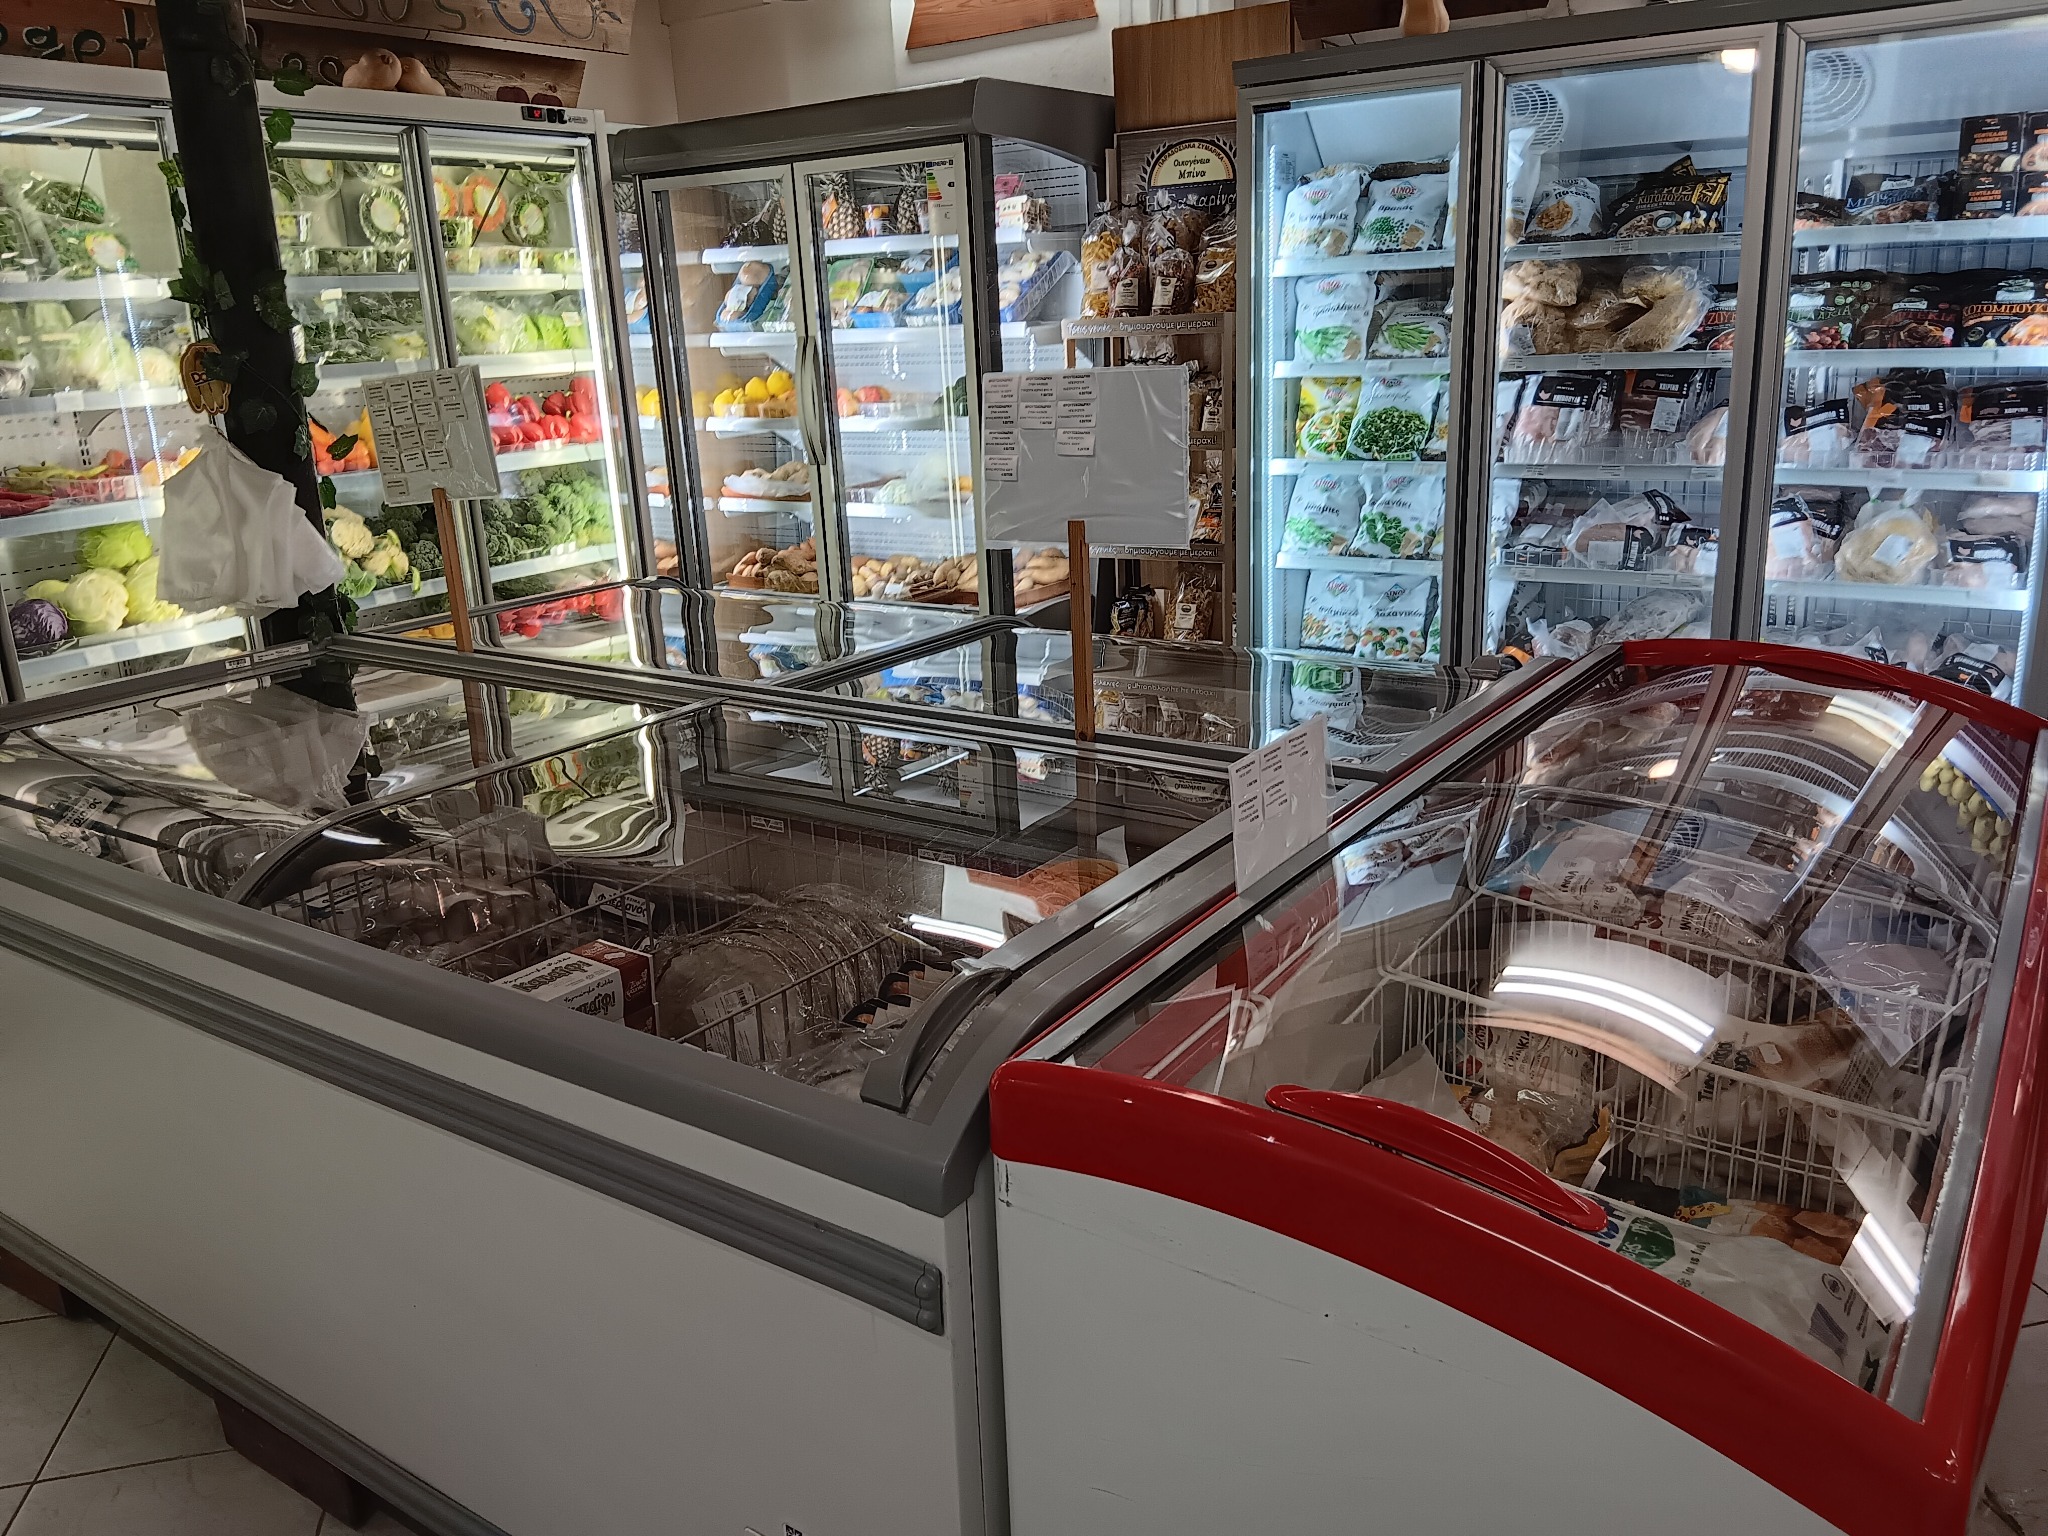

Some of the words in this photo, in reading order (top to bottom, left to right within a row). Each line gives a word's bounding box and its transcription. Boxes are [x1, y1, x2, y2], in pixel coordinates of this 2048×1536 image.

[1158, 143, 1196, 167] ΠΑΡΑΔΟΣΙΑΚΑ
[1197, 143, 1224, 162] ΖΥΜΑΡΙΚΑ
[1173, 155, 1211, 168] Οικογένεια
[1178, 167, 1207, 180] Μπίνα
[1119, 319, 1175, 334] δημιουργούμε
[1176, 321, 1187, 332] με
[1187, 317, 1218, 331] μεράκι!
[1124, 546, 1178, 558] δημιουργούμε
[1180, 550, 1188, 558] με
[1189, 548, 1218, 558] μεράκι!
